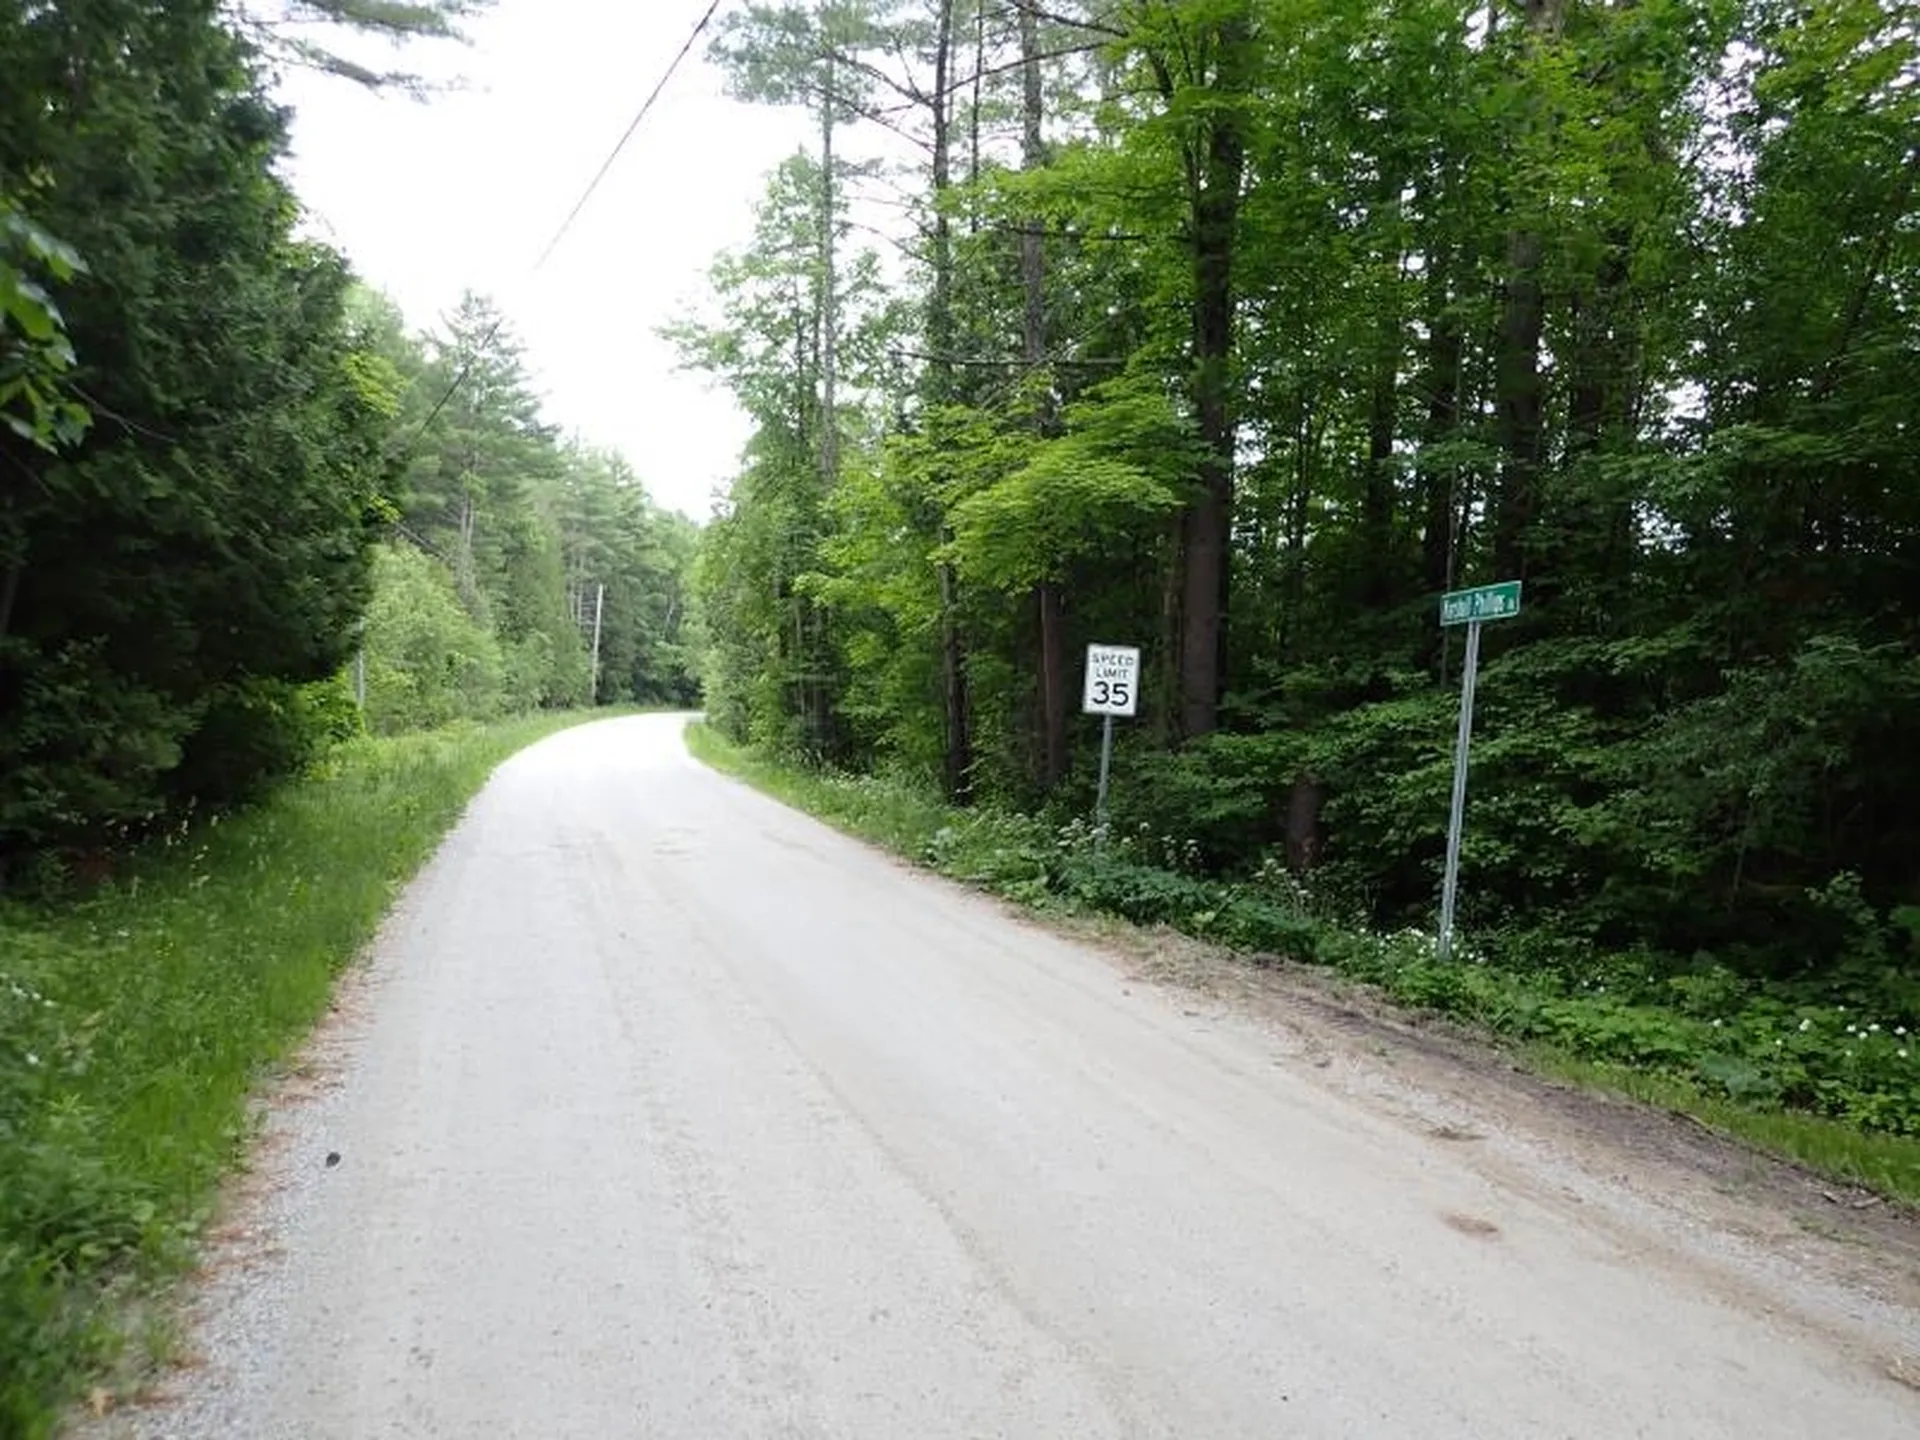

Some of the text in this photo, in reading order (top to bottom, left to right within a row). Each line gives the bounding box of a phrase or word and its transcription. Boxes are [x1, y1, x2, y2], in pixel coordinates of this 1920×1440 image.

[1092, 652, 1134, 666] SPEED
[1096, 668, 1129, 679] LIMIT
[1092, 681, 1129, 707] 35
